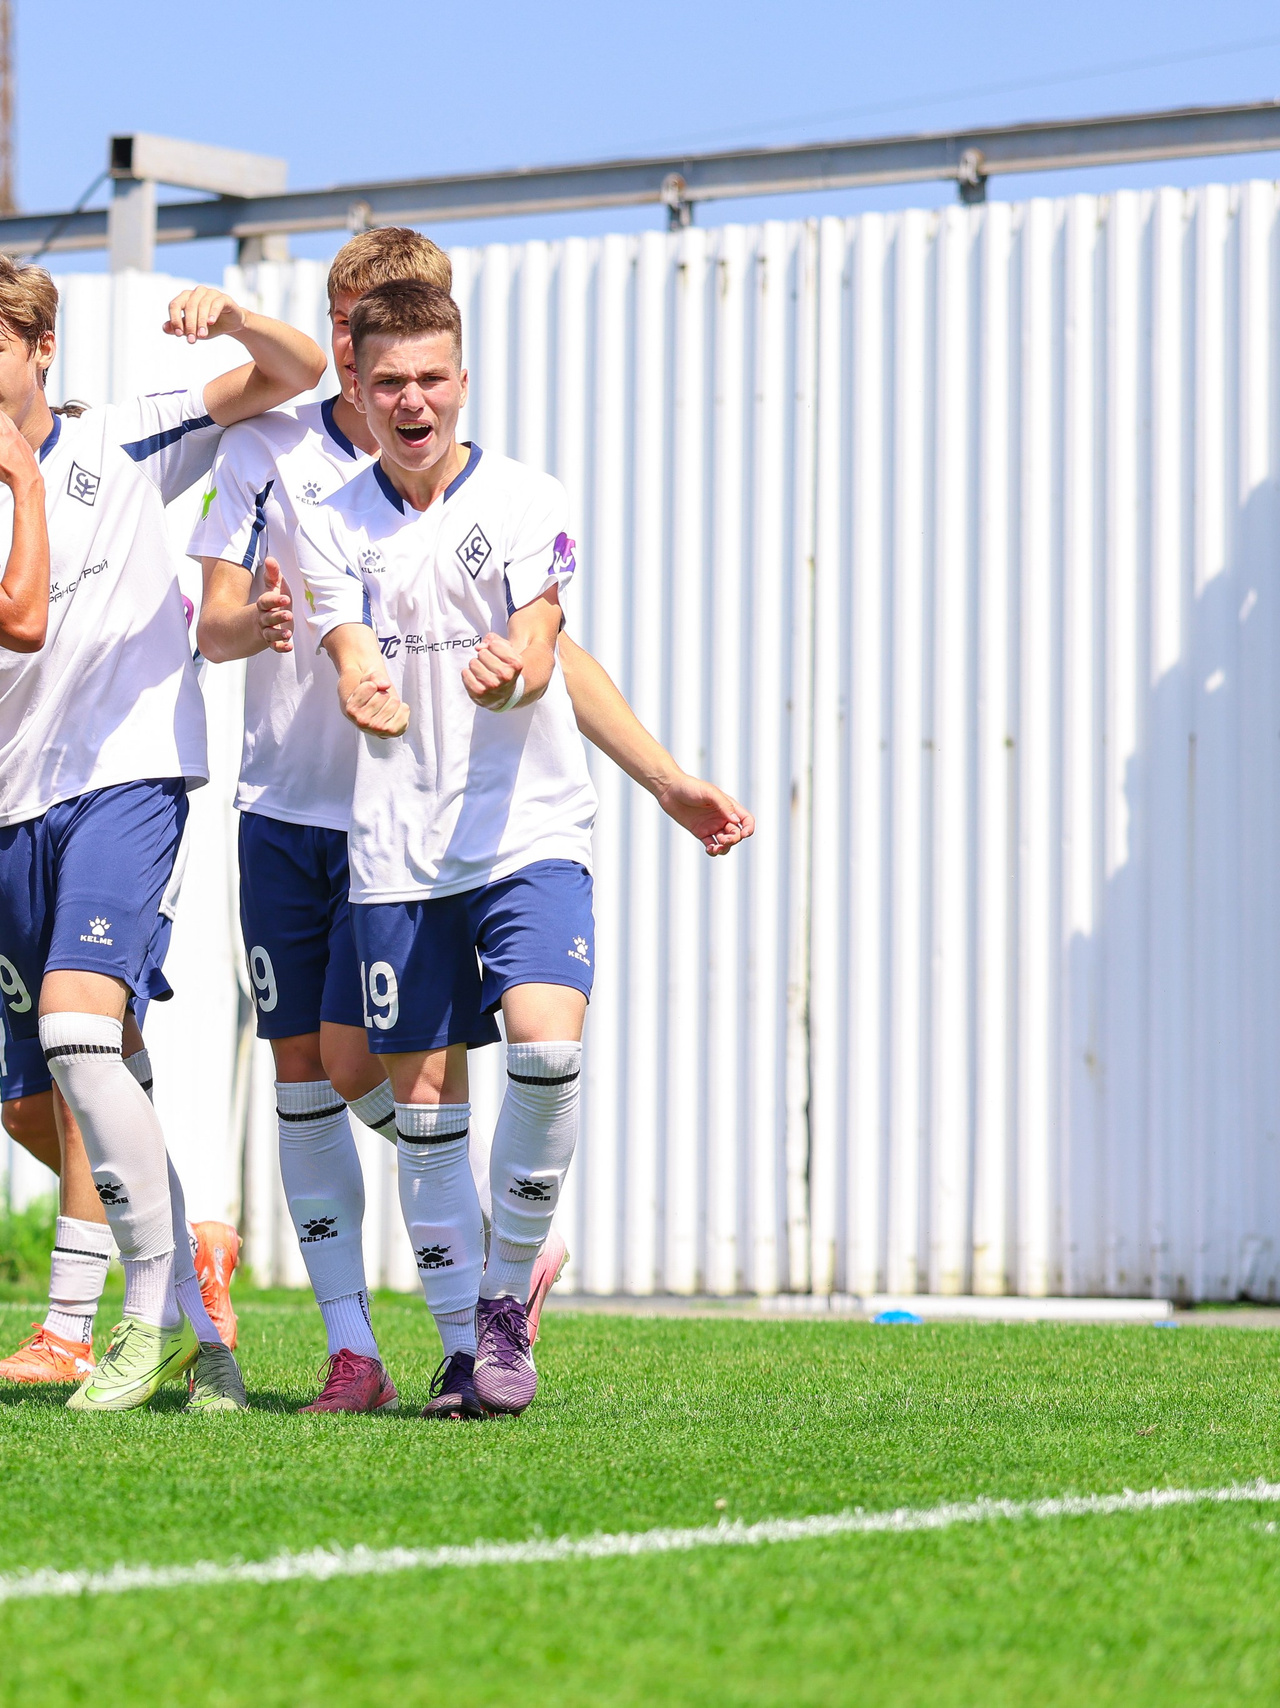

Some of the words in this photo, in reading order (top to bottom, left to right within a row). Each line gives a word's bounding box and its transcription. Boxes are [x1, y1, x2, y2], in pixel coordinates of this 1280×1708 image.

[295, 494, 320, 506] KELM
[80, 934, 113, 946] KELME
[248, 945, 279, 1012] 9
[509, 1187, 551, 1201] KELME
[99, 1196, 129, 1205] ELME
[300, 1230, 338, 1243] KELME
[417, 1258, 454, 1269] KELME
